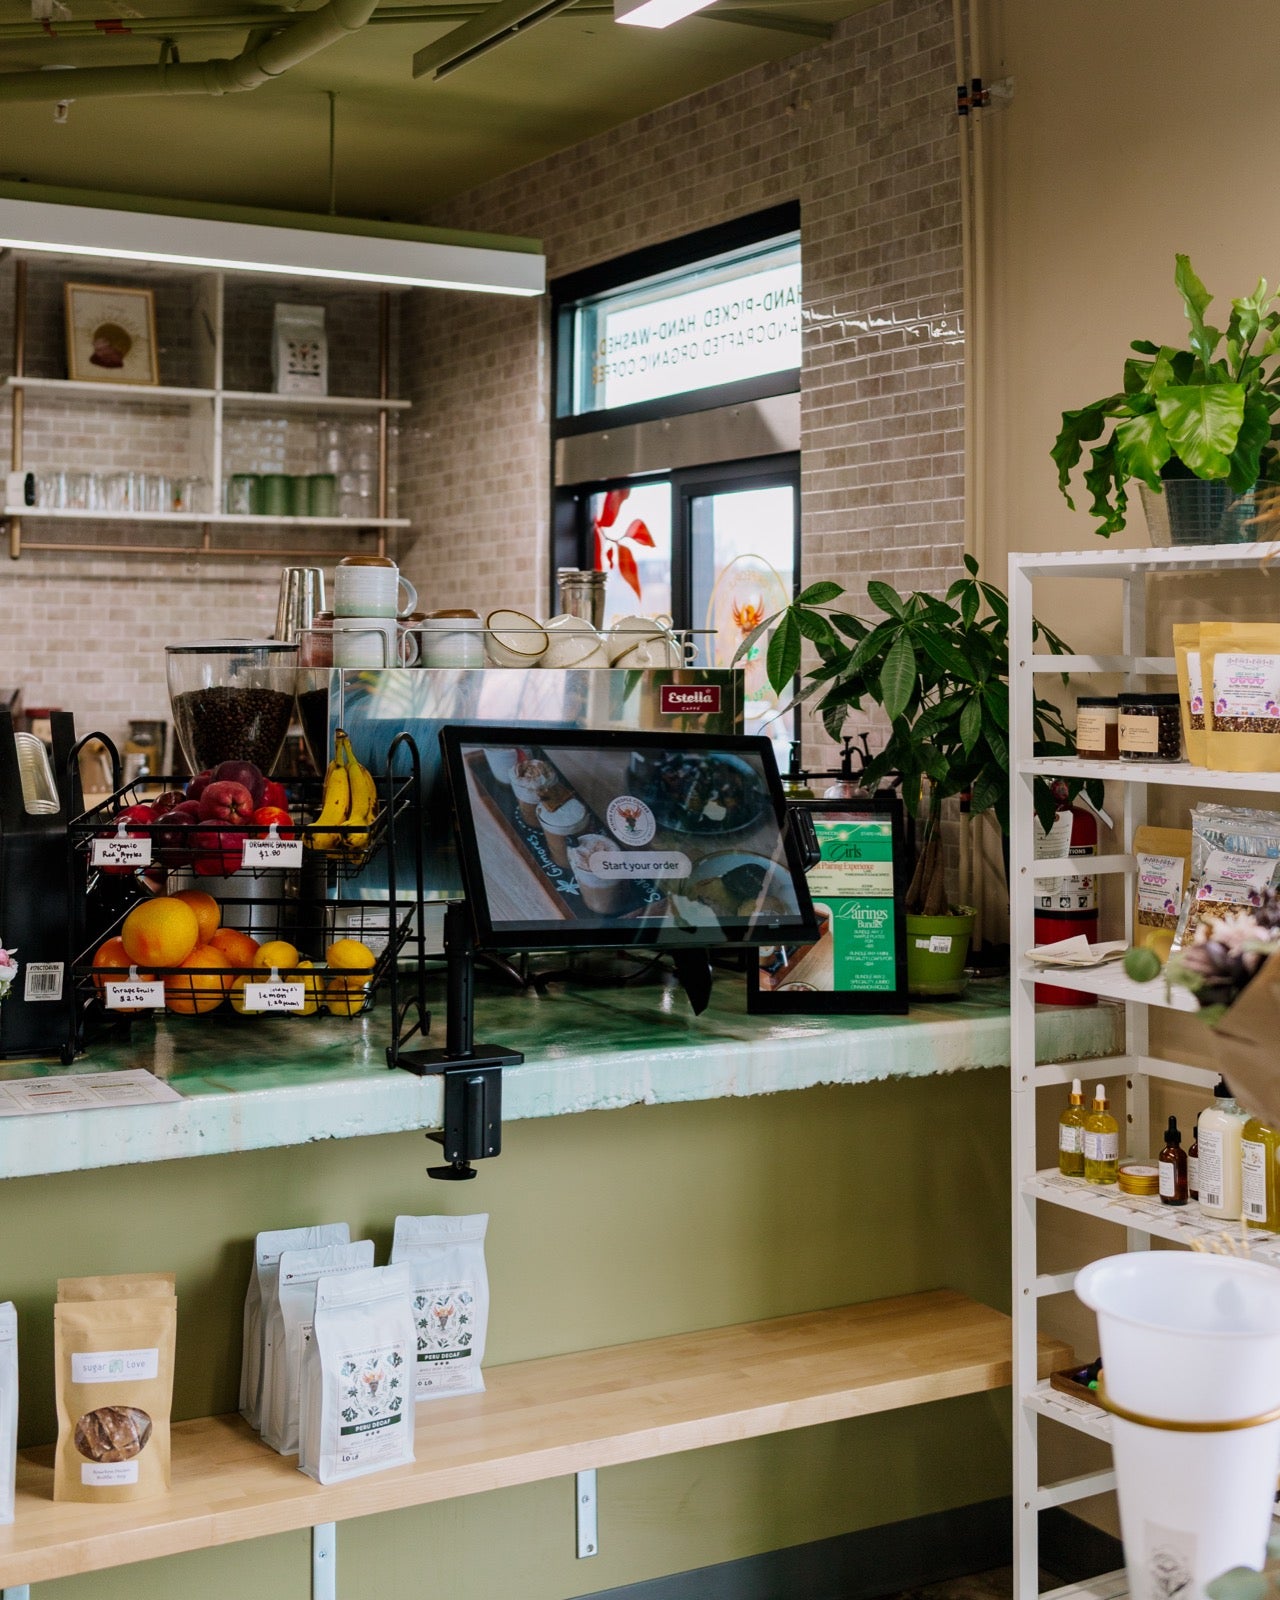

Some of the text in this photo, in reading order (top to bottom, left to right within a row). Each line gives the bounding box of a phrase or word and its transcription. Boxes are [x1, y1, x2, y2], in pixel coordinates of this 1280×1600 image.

[668, 691, 713, 703] Estella
[249, 841, 274, 849] ORGANIC
[102, 851, 116, 859] Red
[828, 844, 862, 862] Girls
[602, 861, 679, 872] Start your order
[835, 901, 888, 920] Pairings
[857, 919, 883, 929] Bundles
[424, 1351, 460, 1361] PERU DECAF
[82, 1362, 107, 1373] sugar
[355, 1418, 391, 1433] PERU DECAF
